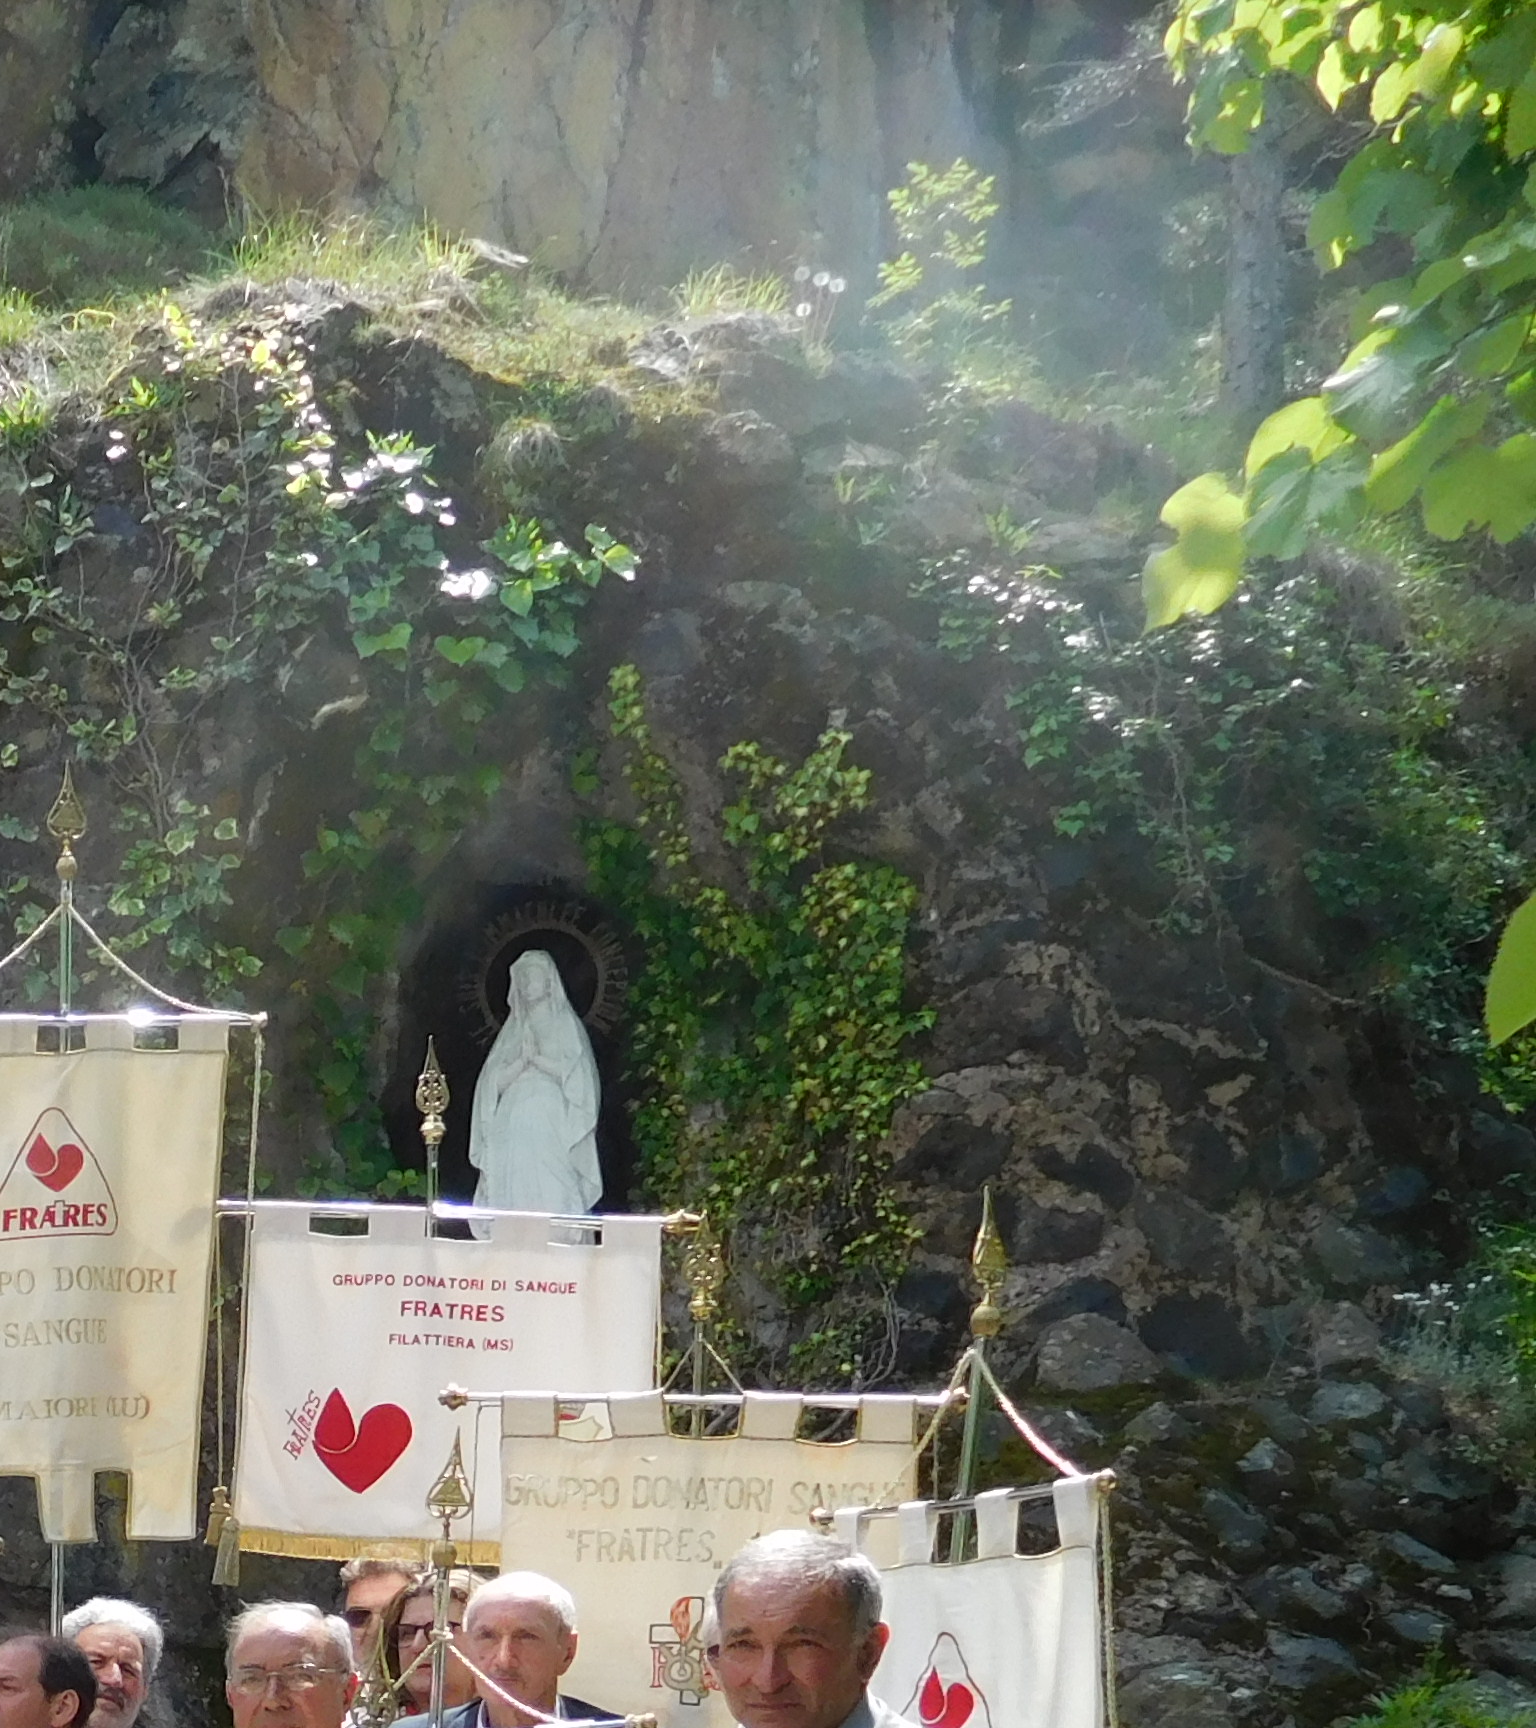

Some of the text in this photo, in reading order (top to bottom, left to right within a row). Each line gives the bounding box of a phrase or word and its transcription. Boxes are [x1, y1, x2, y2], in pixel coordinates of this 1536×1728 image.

[2, 1199, 107, 1232] FRATRES
[53, 1265, 177, 1294] DONATORI
[332, 1274, 578, 1294] GRUPPO DONATORI DI SANGUE
[400, 1301, 505, 1322] FRATRES
[4, 1317, 107, 1348] SANGUE
[389, 1333, 514, 1351] FILATTIERA (MS)
[507, 1474, 619, 1511] GRUPPO
[632, 1475, 773, 1512] DONATORI
